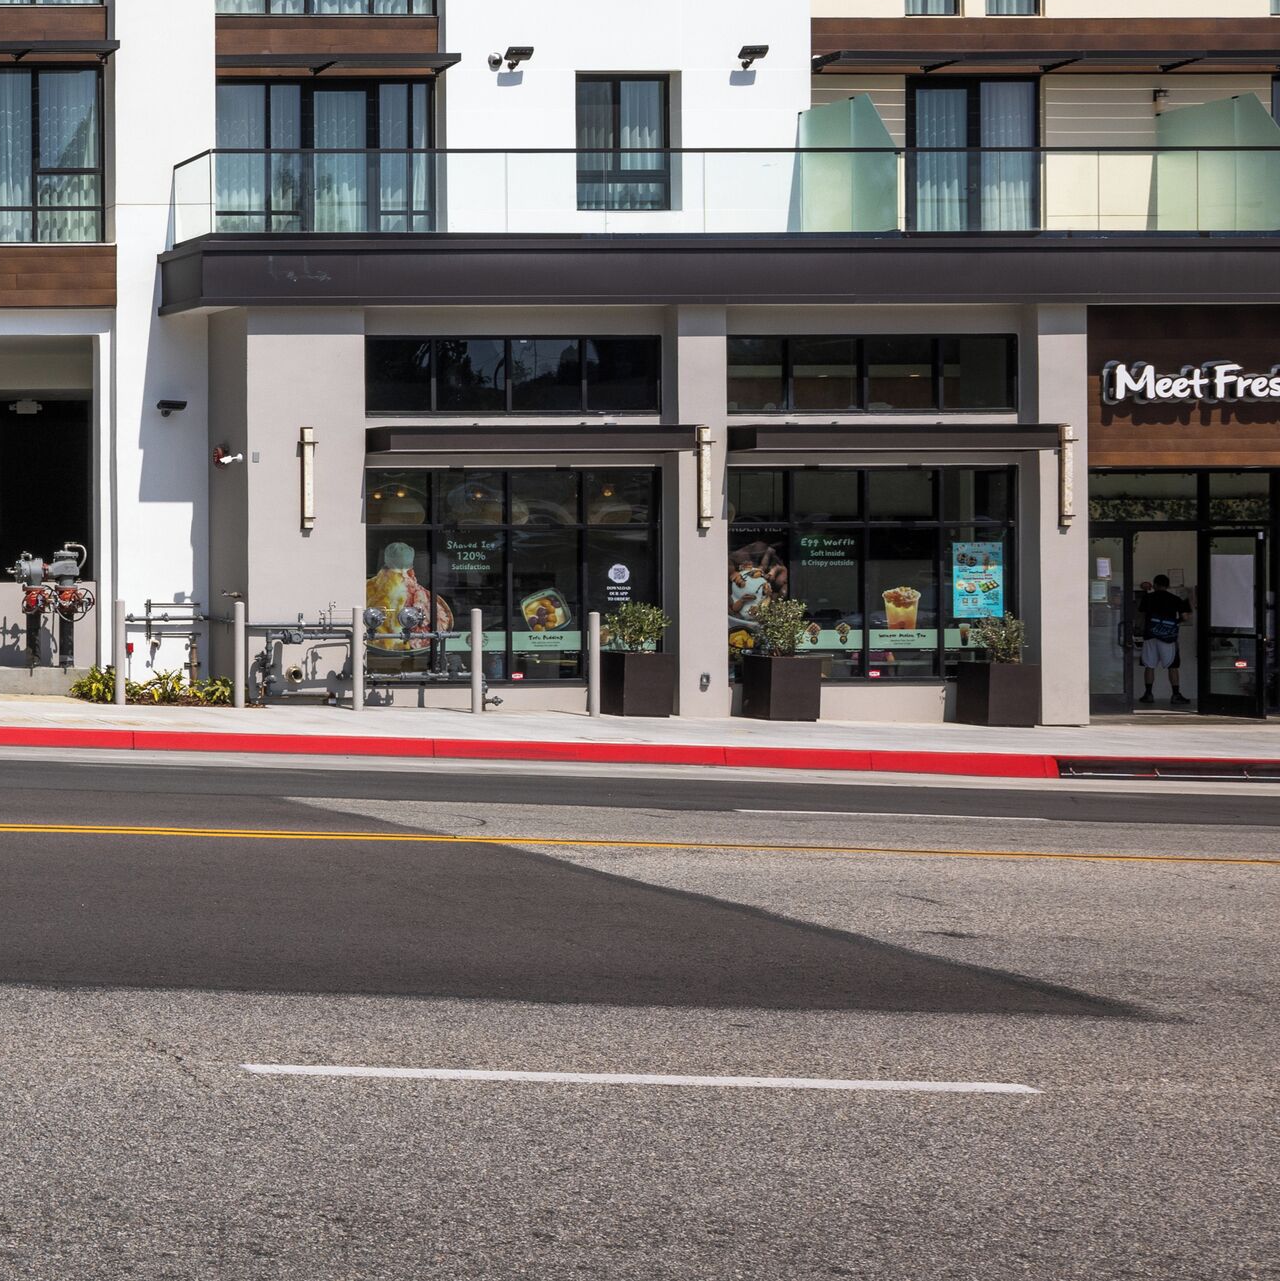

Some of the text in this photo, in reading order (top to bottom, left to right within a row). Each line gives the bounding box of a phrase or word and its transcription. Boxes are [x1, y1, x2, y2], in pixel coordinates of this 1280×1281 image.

[1115, 363, 1209, 400] Meet
[447, 540, 498, 551] Shaved Ice
[801, 537, 855, 547] Egg Waffle
[456, 551, 486, 561] 120%
[451, 563, 491, 571] Satisfaction
[807, 559, 828, 567] Crispy
